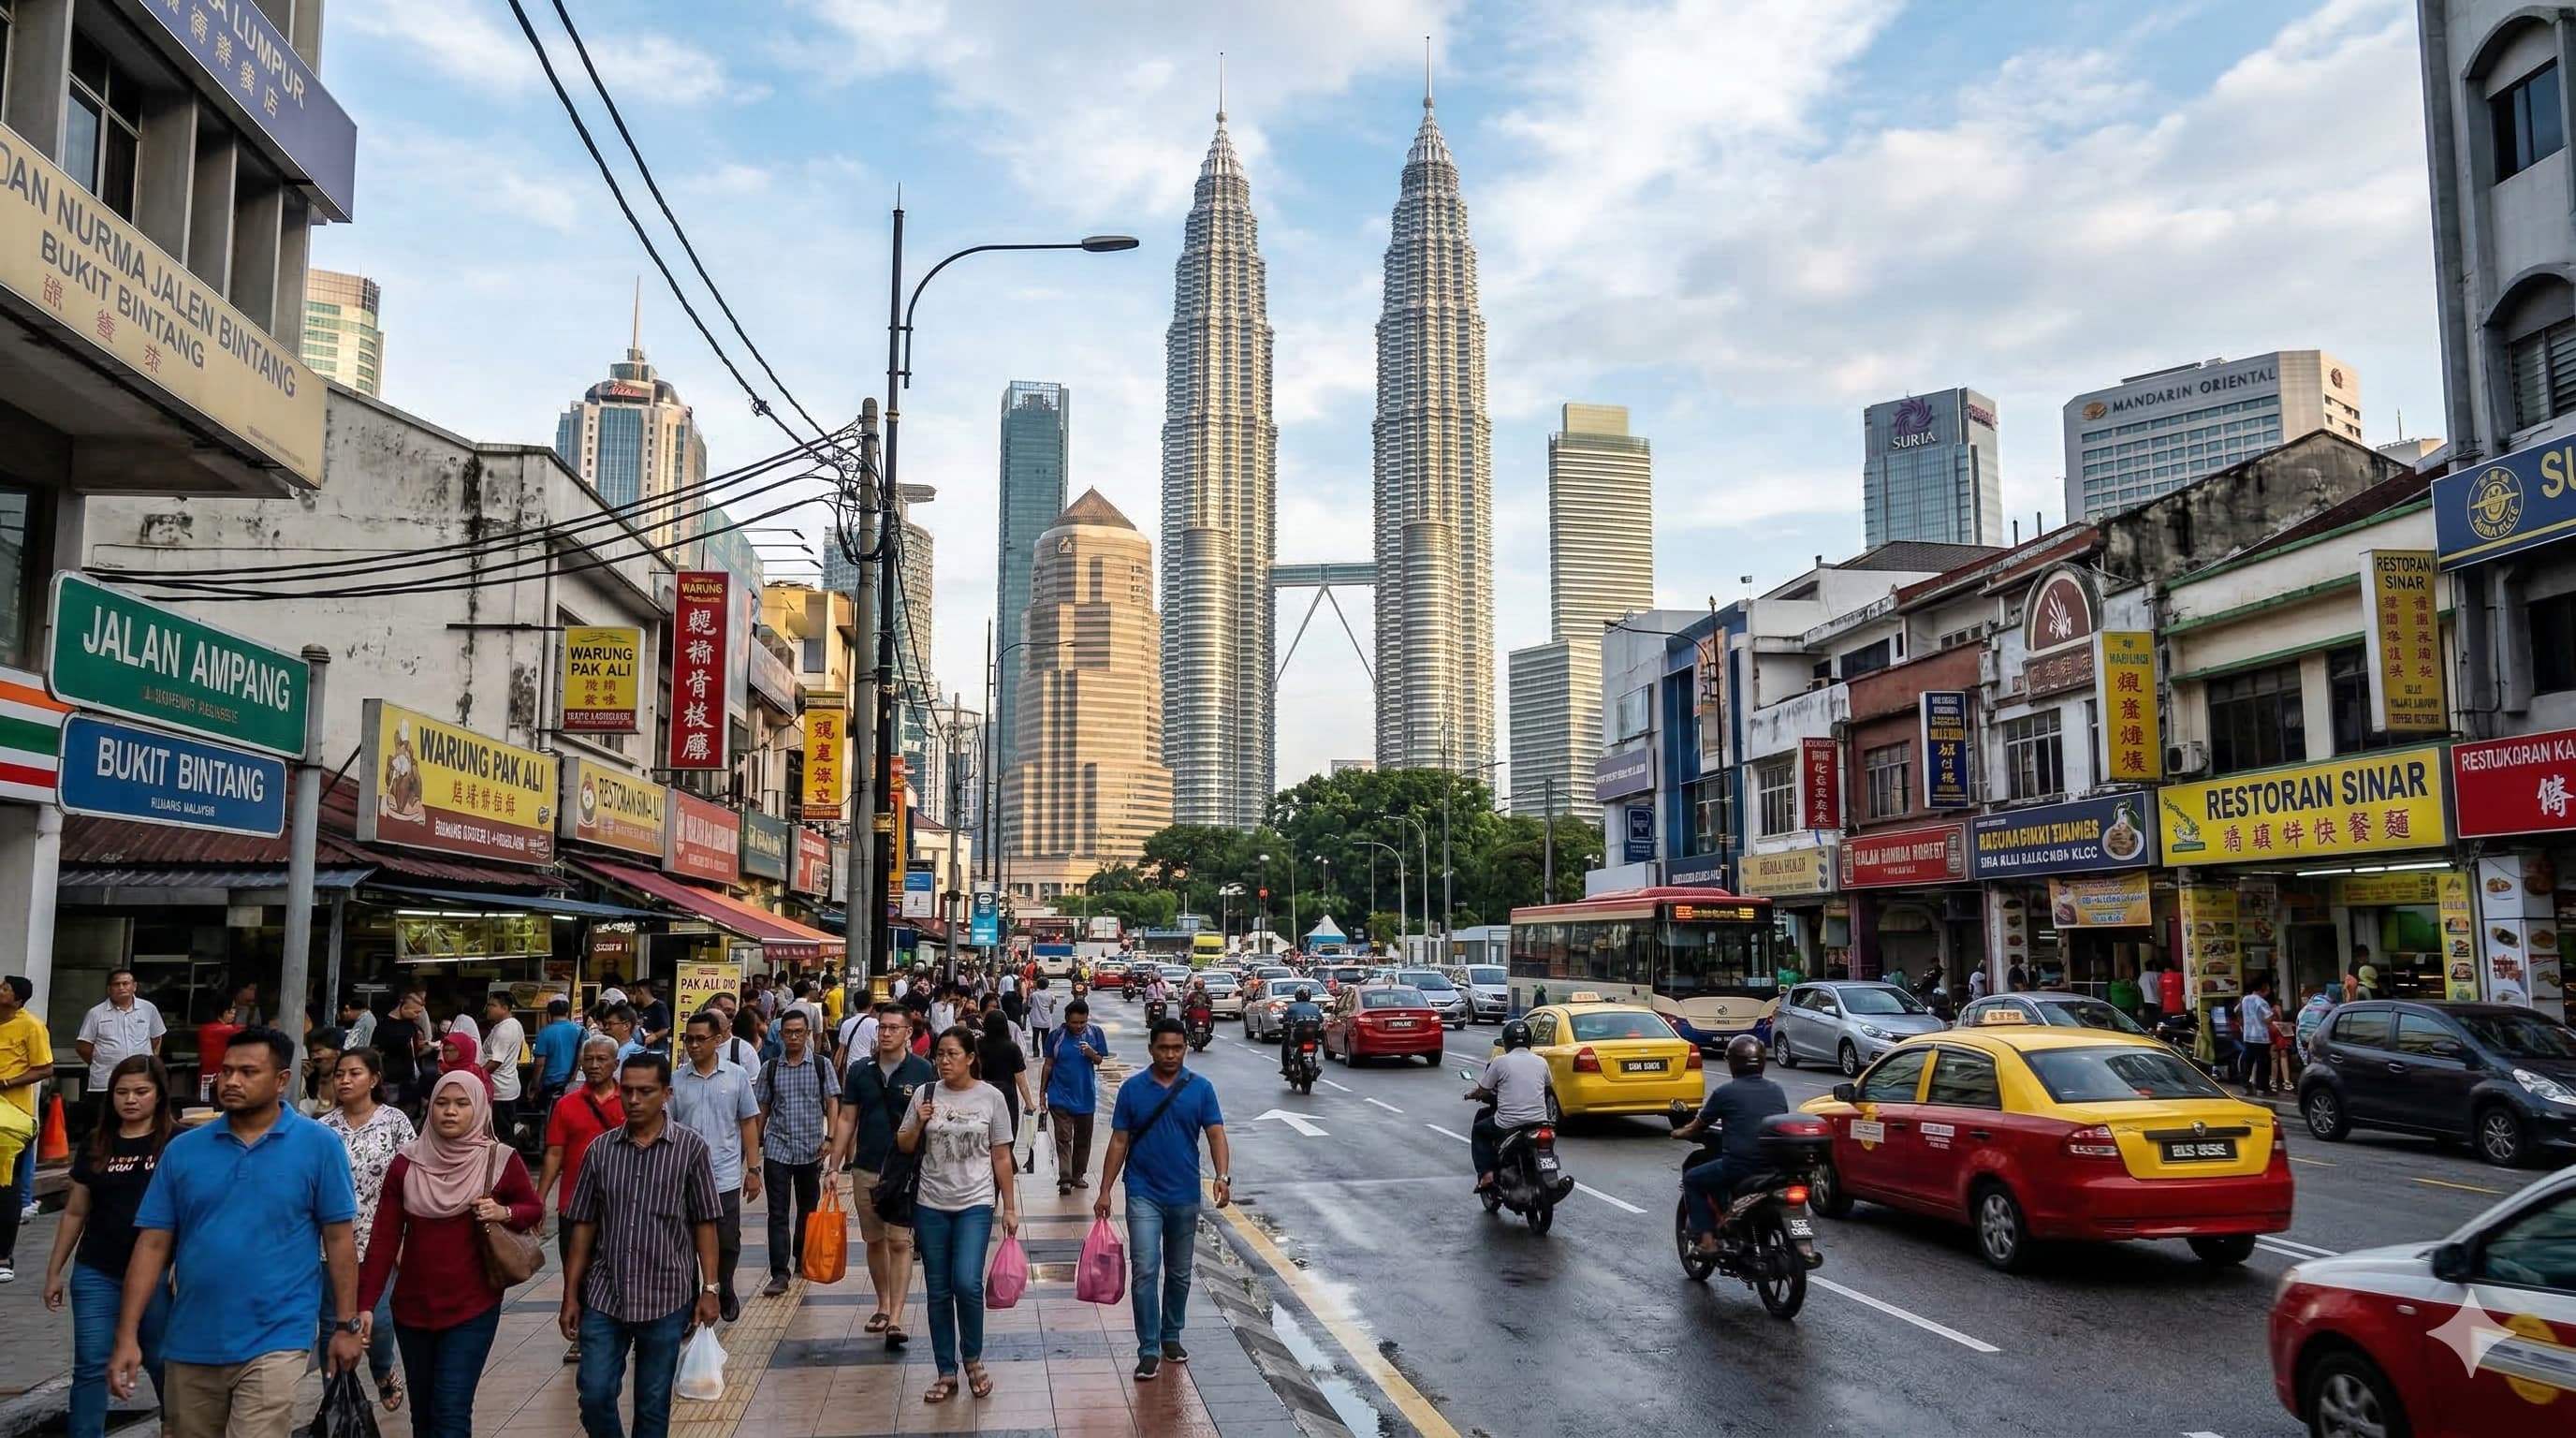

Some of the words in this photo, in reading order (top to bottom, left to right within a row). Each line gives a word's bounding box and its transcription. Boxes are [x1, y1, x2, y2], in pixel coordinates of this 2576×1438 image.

[233, 4, 305, 110] LUMPUR
[41, 229, 111, 301] BUKIT
[118, 285, 204, 370] BINTANG
[57, 188, 146, 288] NURMA
[151, 265, 214, 337] JALEN
[218, 315, 296, 398] BINTANG
[2113, 385, 2192, 413] MANDARIN
[2200, 368, 2276, 394] ORIENTAL
[1893, 432, 1936, 449] SURIA
[2377, 557, 2431, 572] RESTORAN
[681, 583, 723, 594] WARUNG
[2385, 576, 2425, 590] SINAR
[83, 606, 181, 678] JALAN
[190, 641, 290, 712] AMPANG
[570, 647, 633, 661] WARUNG
[571, 663, 601, 676] PAK
[607, 663, 631, 676] ALI
[97, 736, 170, 786] BUKIT
[178, 753, 264, 802] BINTANG
[419, 726, 489, 778] WARUNG
[493, 750, 520, 787] PAK
[522, 759, 545, 793] ALI
[2206, 774, 2334, 821] RESTORAN
[2342, 761, 2428, 805] SINAR
[2072, 846, 2098, 860] KLCC
[681, 978, 700, 990] PAK
